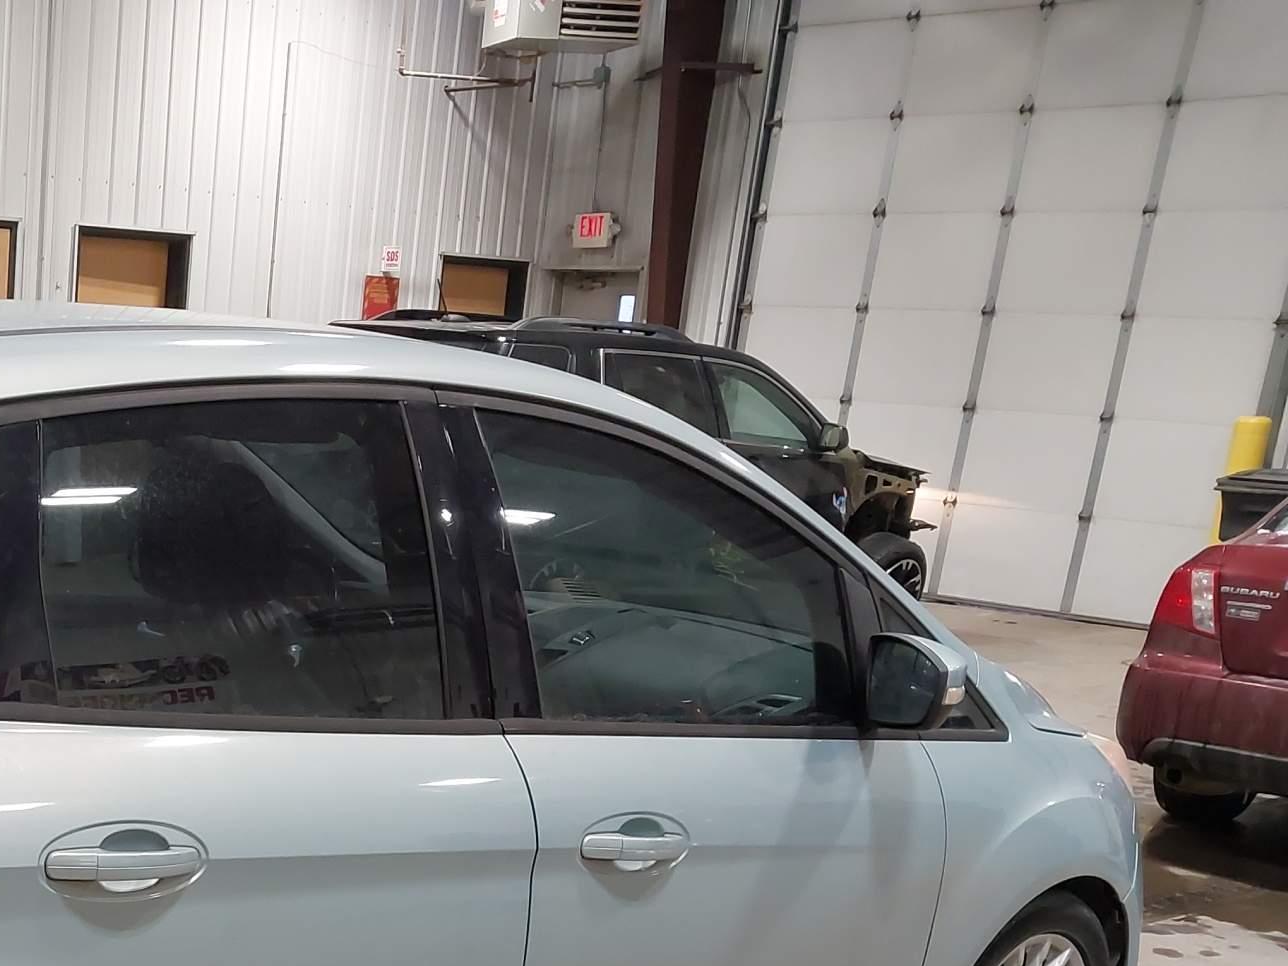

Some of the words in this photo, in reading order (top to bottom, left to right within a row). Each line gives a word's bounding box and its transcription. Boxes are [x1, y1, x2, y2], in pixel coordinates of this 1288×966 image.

[580, 215, 604, 238] EXIT
[386, 250, 399, 262] SDS
[1221, 586, 1280, 599] SUBARU
